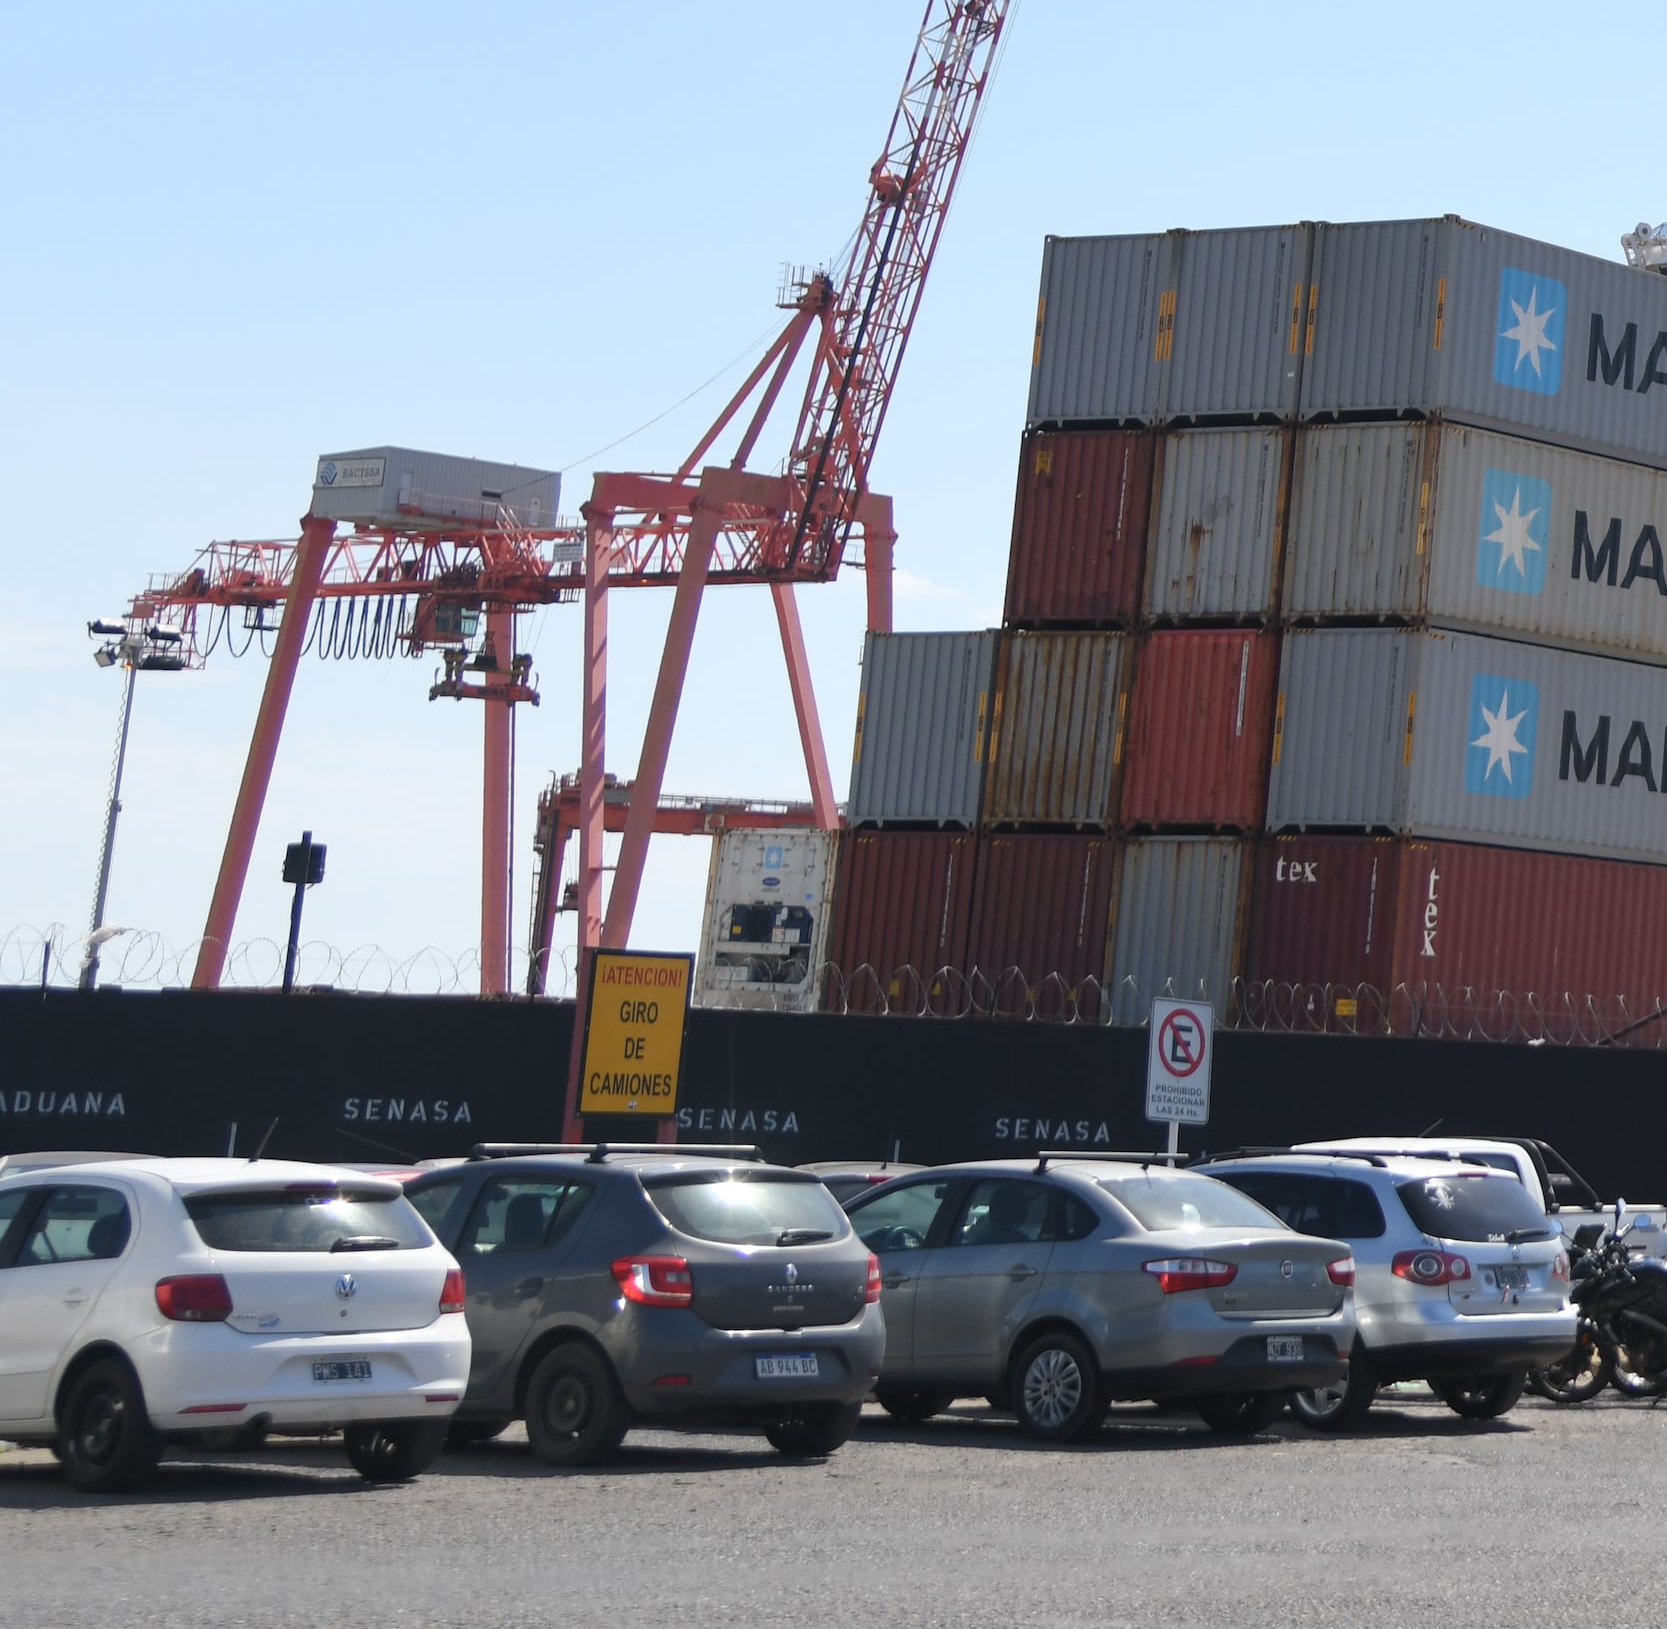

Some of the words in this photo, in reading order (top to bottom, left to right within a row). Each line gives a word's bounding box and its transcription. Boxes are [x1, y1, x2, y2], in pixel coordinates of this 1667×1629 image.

[1276, 855, 1319, 883] tex
[1420, 866, 1440, 956] tex
[620, 1000, 659, 1024] GIRO
[624, 1037, 646, 1059] DE
[589, 1072, 673, 1097] CAMIONES
[1155, 1083, 1203, 1097] PROHIBIDO
[343, 1098, 473, 1124] SENASA
[1151, 1093, 1205, 1107] ESTACIONAR
[1175, 1106, 1185, 1116] 24
[677, 1107, 799, 1133] SENASA
[995, 1118, 1111, 1144] SENASA
[777, 1358, 799, 1375] 944
